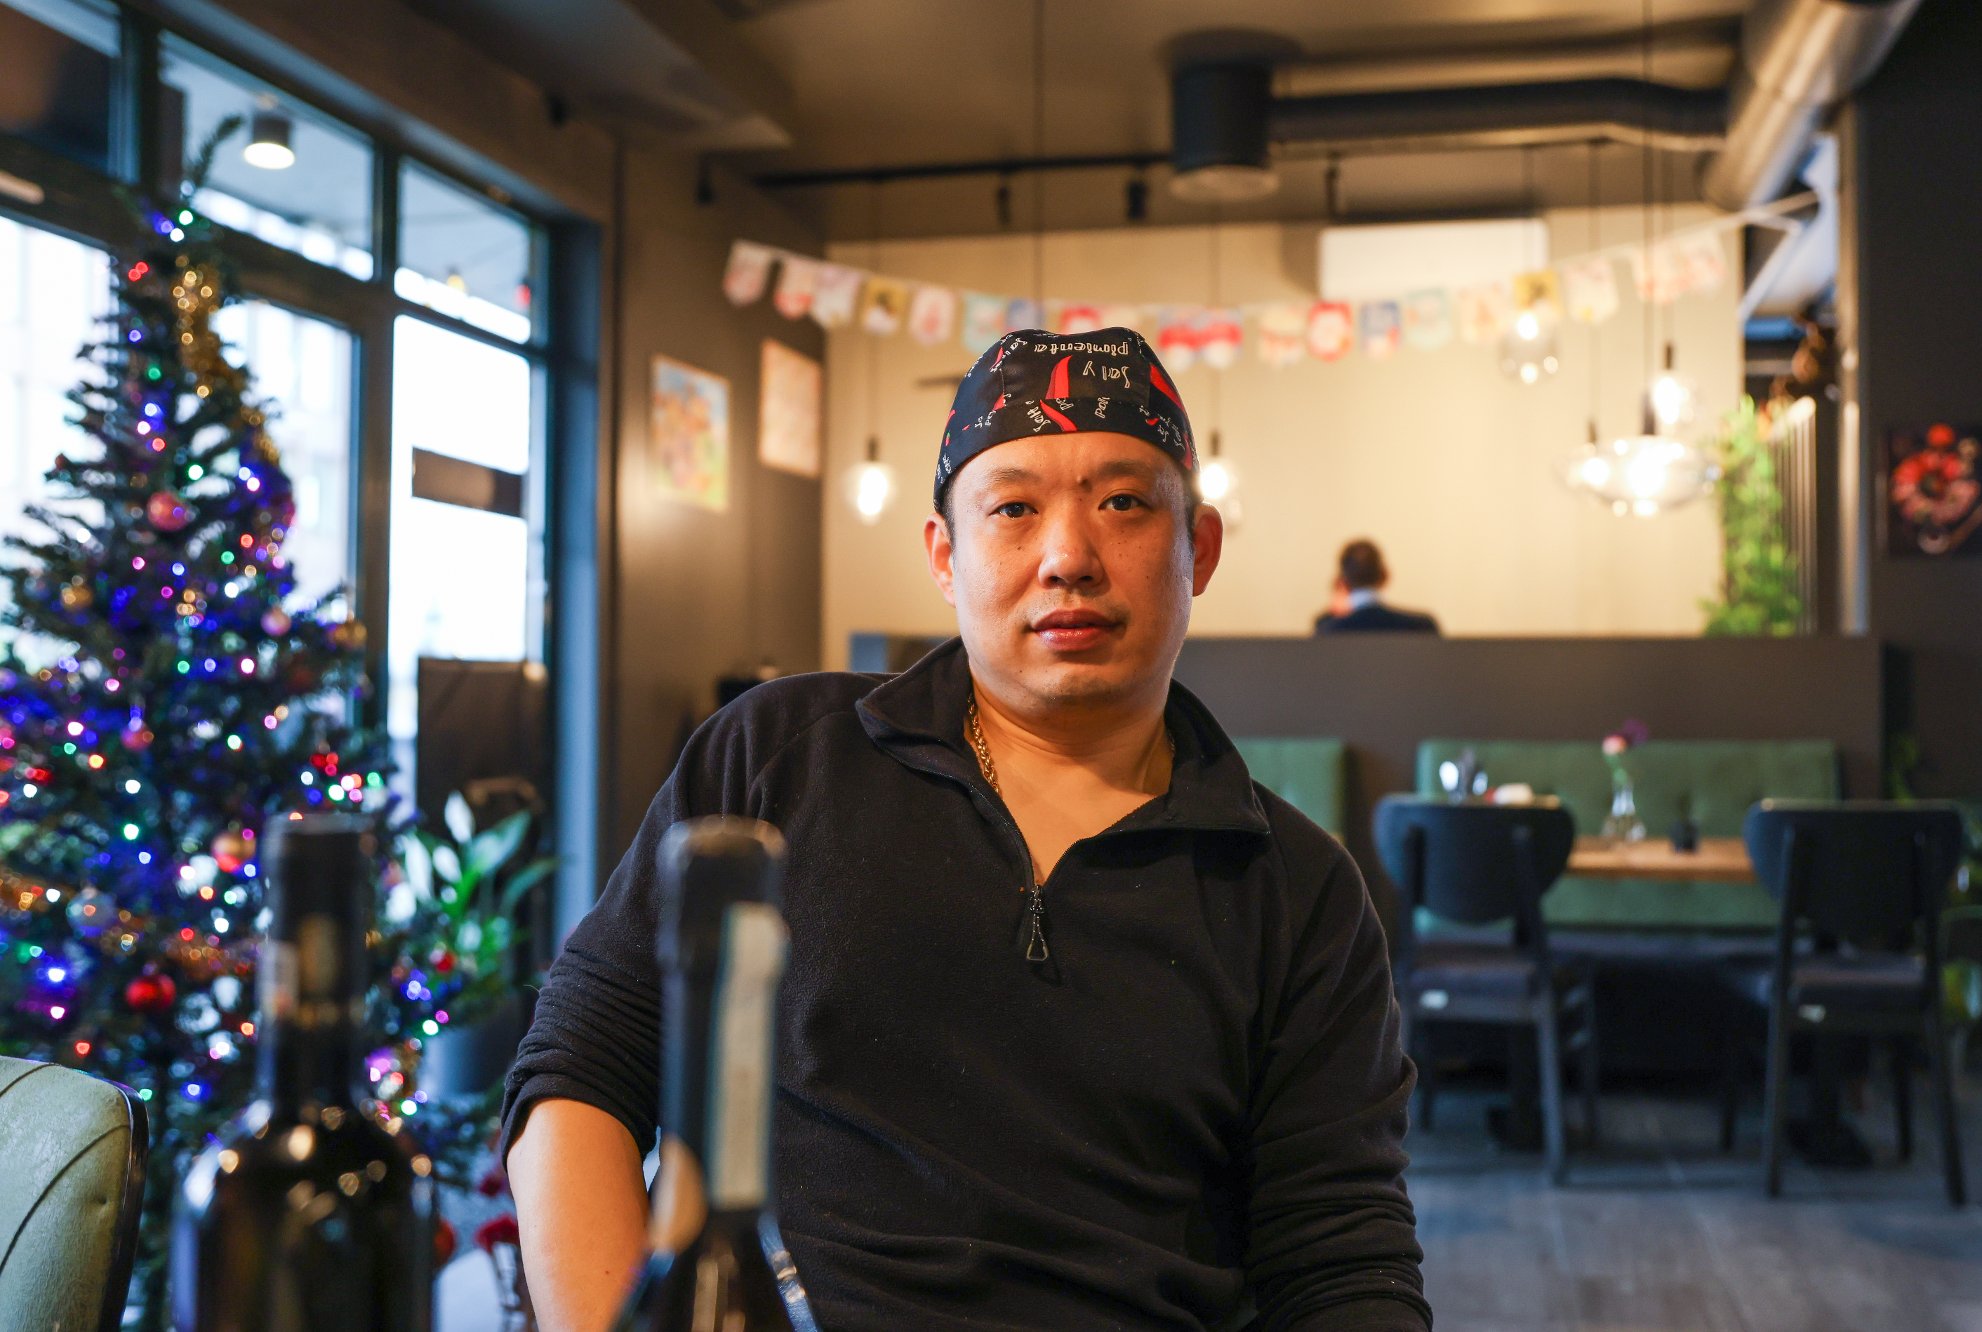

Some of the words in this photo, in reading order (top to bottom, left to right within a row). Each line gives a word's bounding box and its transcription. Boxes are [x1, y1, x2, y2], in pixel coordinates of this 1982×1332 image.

[1033, 341, 1129, 356] pimienta
[1082, 360, 1096, 377] y
[1101, 365, 1131, 389] Sal
